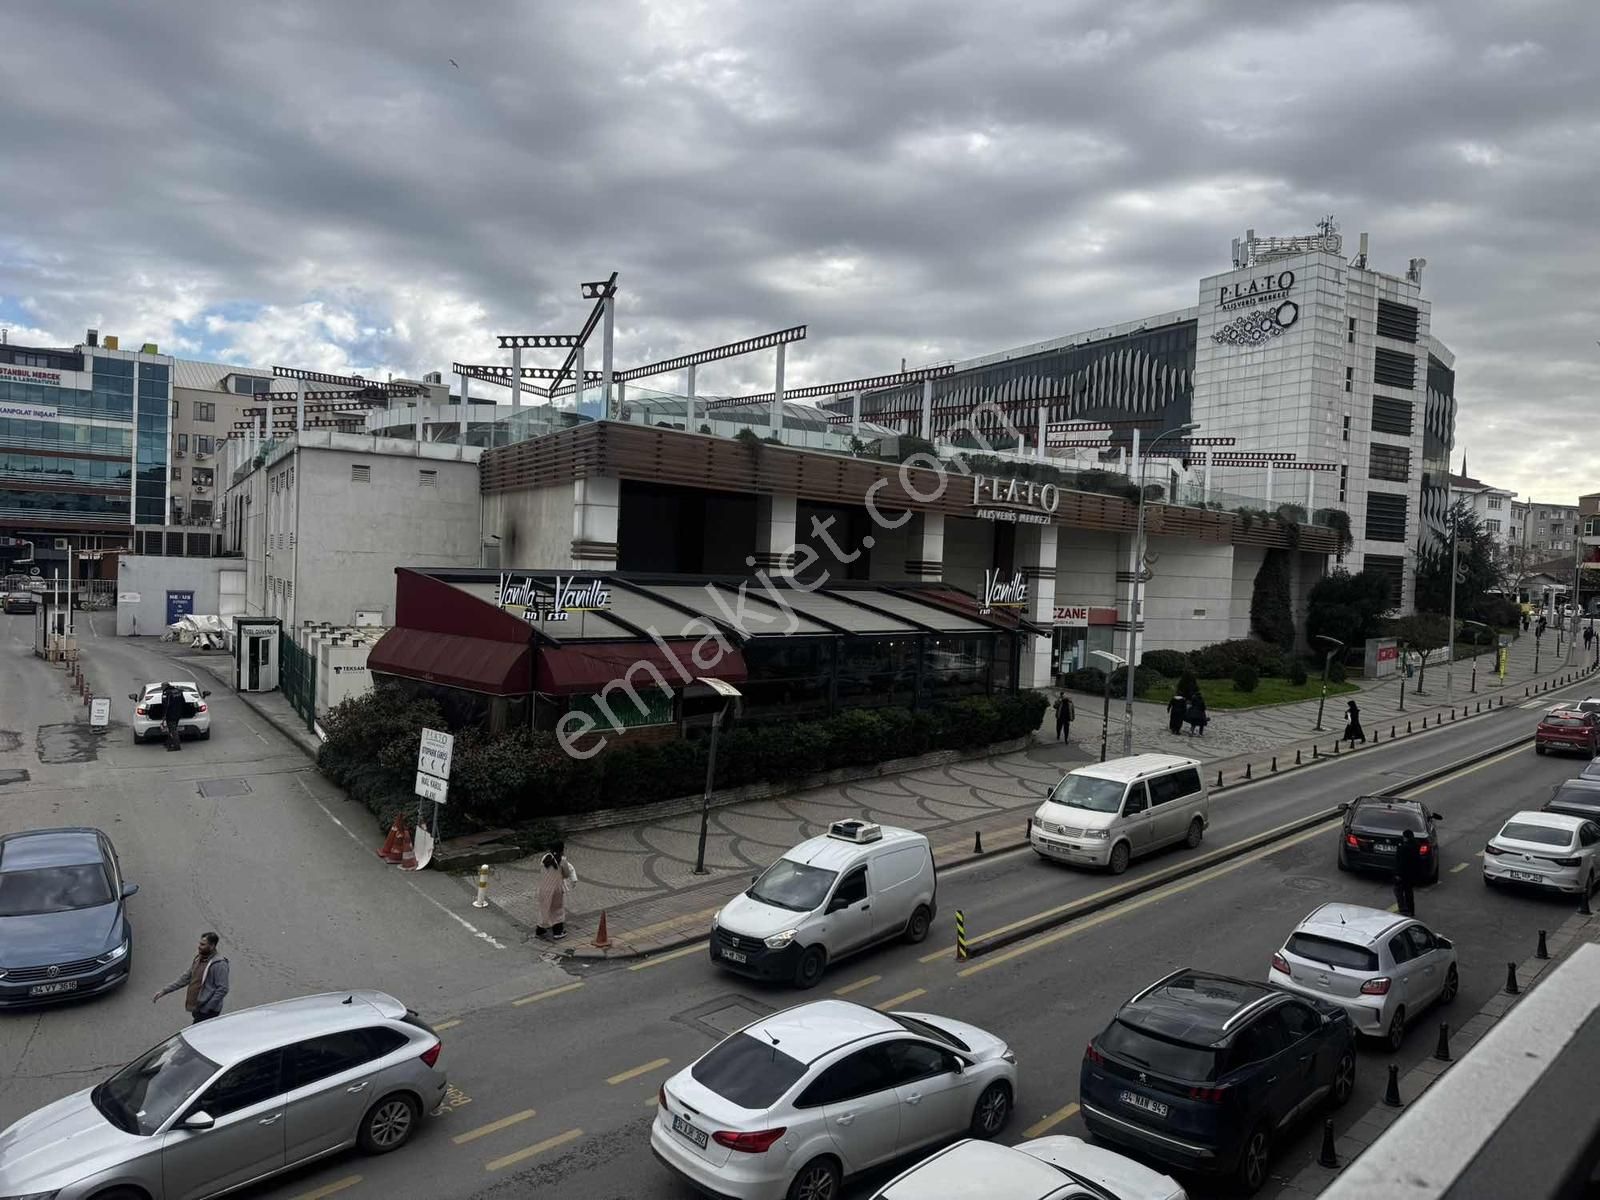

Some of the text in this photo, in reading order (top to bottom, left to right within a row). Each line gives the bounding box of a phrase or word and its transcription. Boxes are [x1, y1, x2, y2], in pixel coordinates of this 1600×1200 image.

[498, 572, 536, 608] Vanilla
[554, 575, 608, 612] Vanilla
[984, 567, 1026, 609] Vanilla
[547, 612, 569, 621] rsn
[1121, 1090, 1132, 1101] 34
[1152, 1102, 1168, 1116] 943
